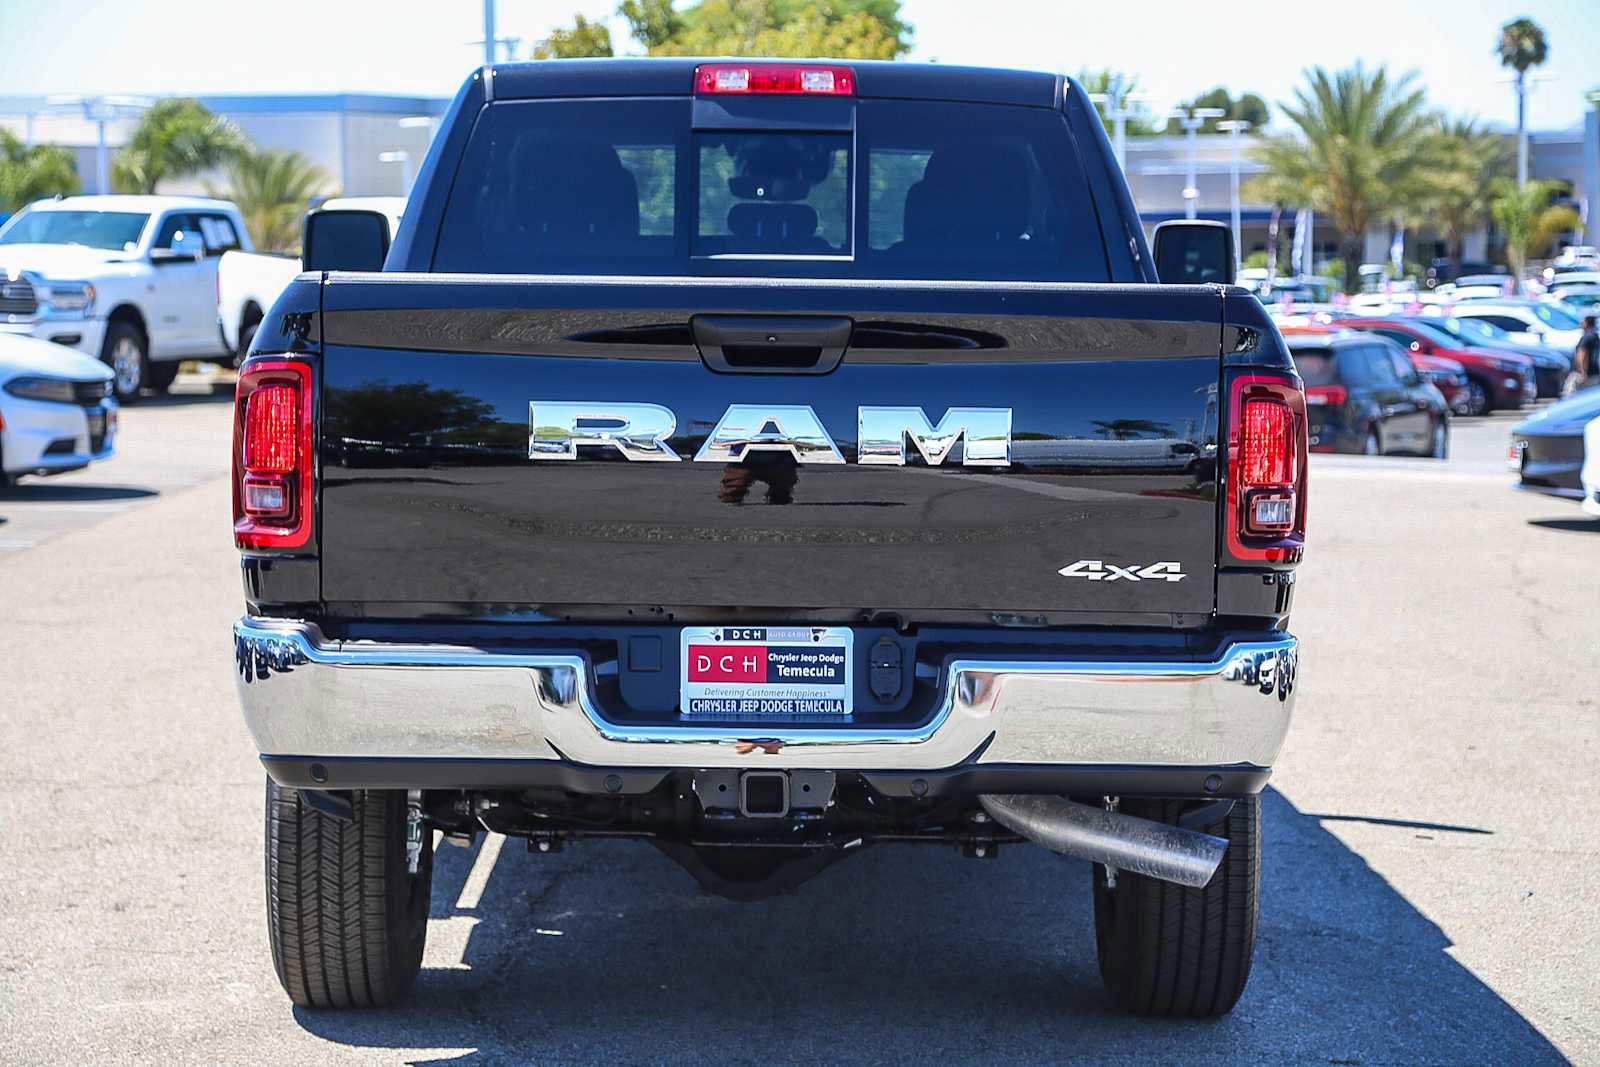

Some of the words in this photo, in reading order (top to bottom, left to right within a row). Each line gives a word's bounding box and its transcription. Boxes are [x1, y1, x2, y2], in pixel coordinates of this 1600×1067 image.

[528, 401, 1013, 467] RAM
[1058, 560, 1187, 582] 4x4
[732, 629, 761, 639] DCH
[768, 653, 799, 663] Chrysler
[800, 653, 818, 663] Jeep
[818, 654, 845, 664] Dodge
[777, 665, 835, 677] Temecula
[704, 687, 746, 698] Delivering
[746, 688, 785, 697] Customer
[692, 700, 737, 712] CHRYSLER
[738, 700, 760, 712] JEEP
[760, 700, 793, 712] DODGE
[794, 700, 843, 712] TEMECULA
